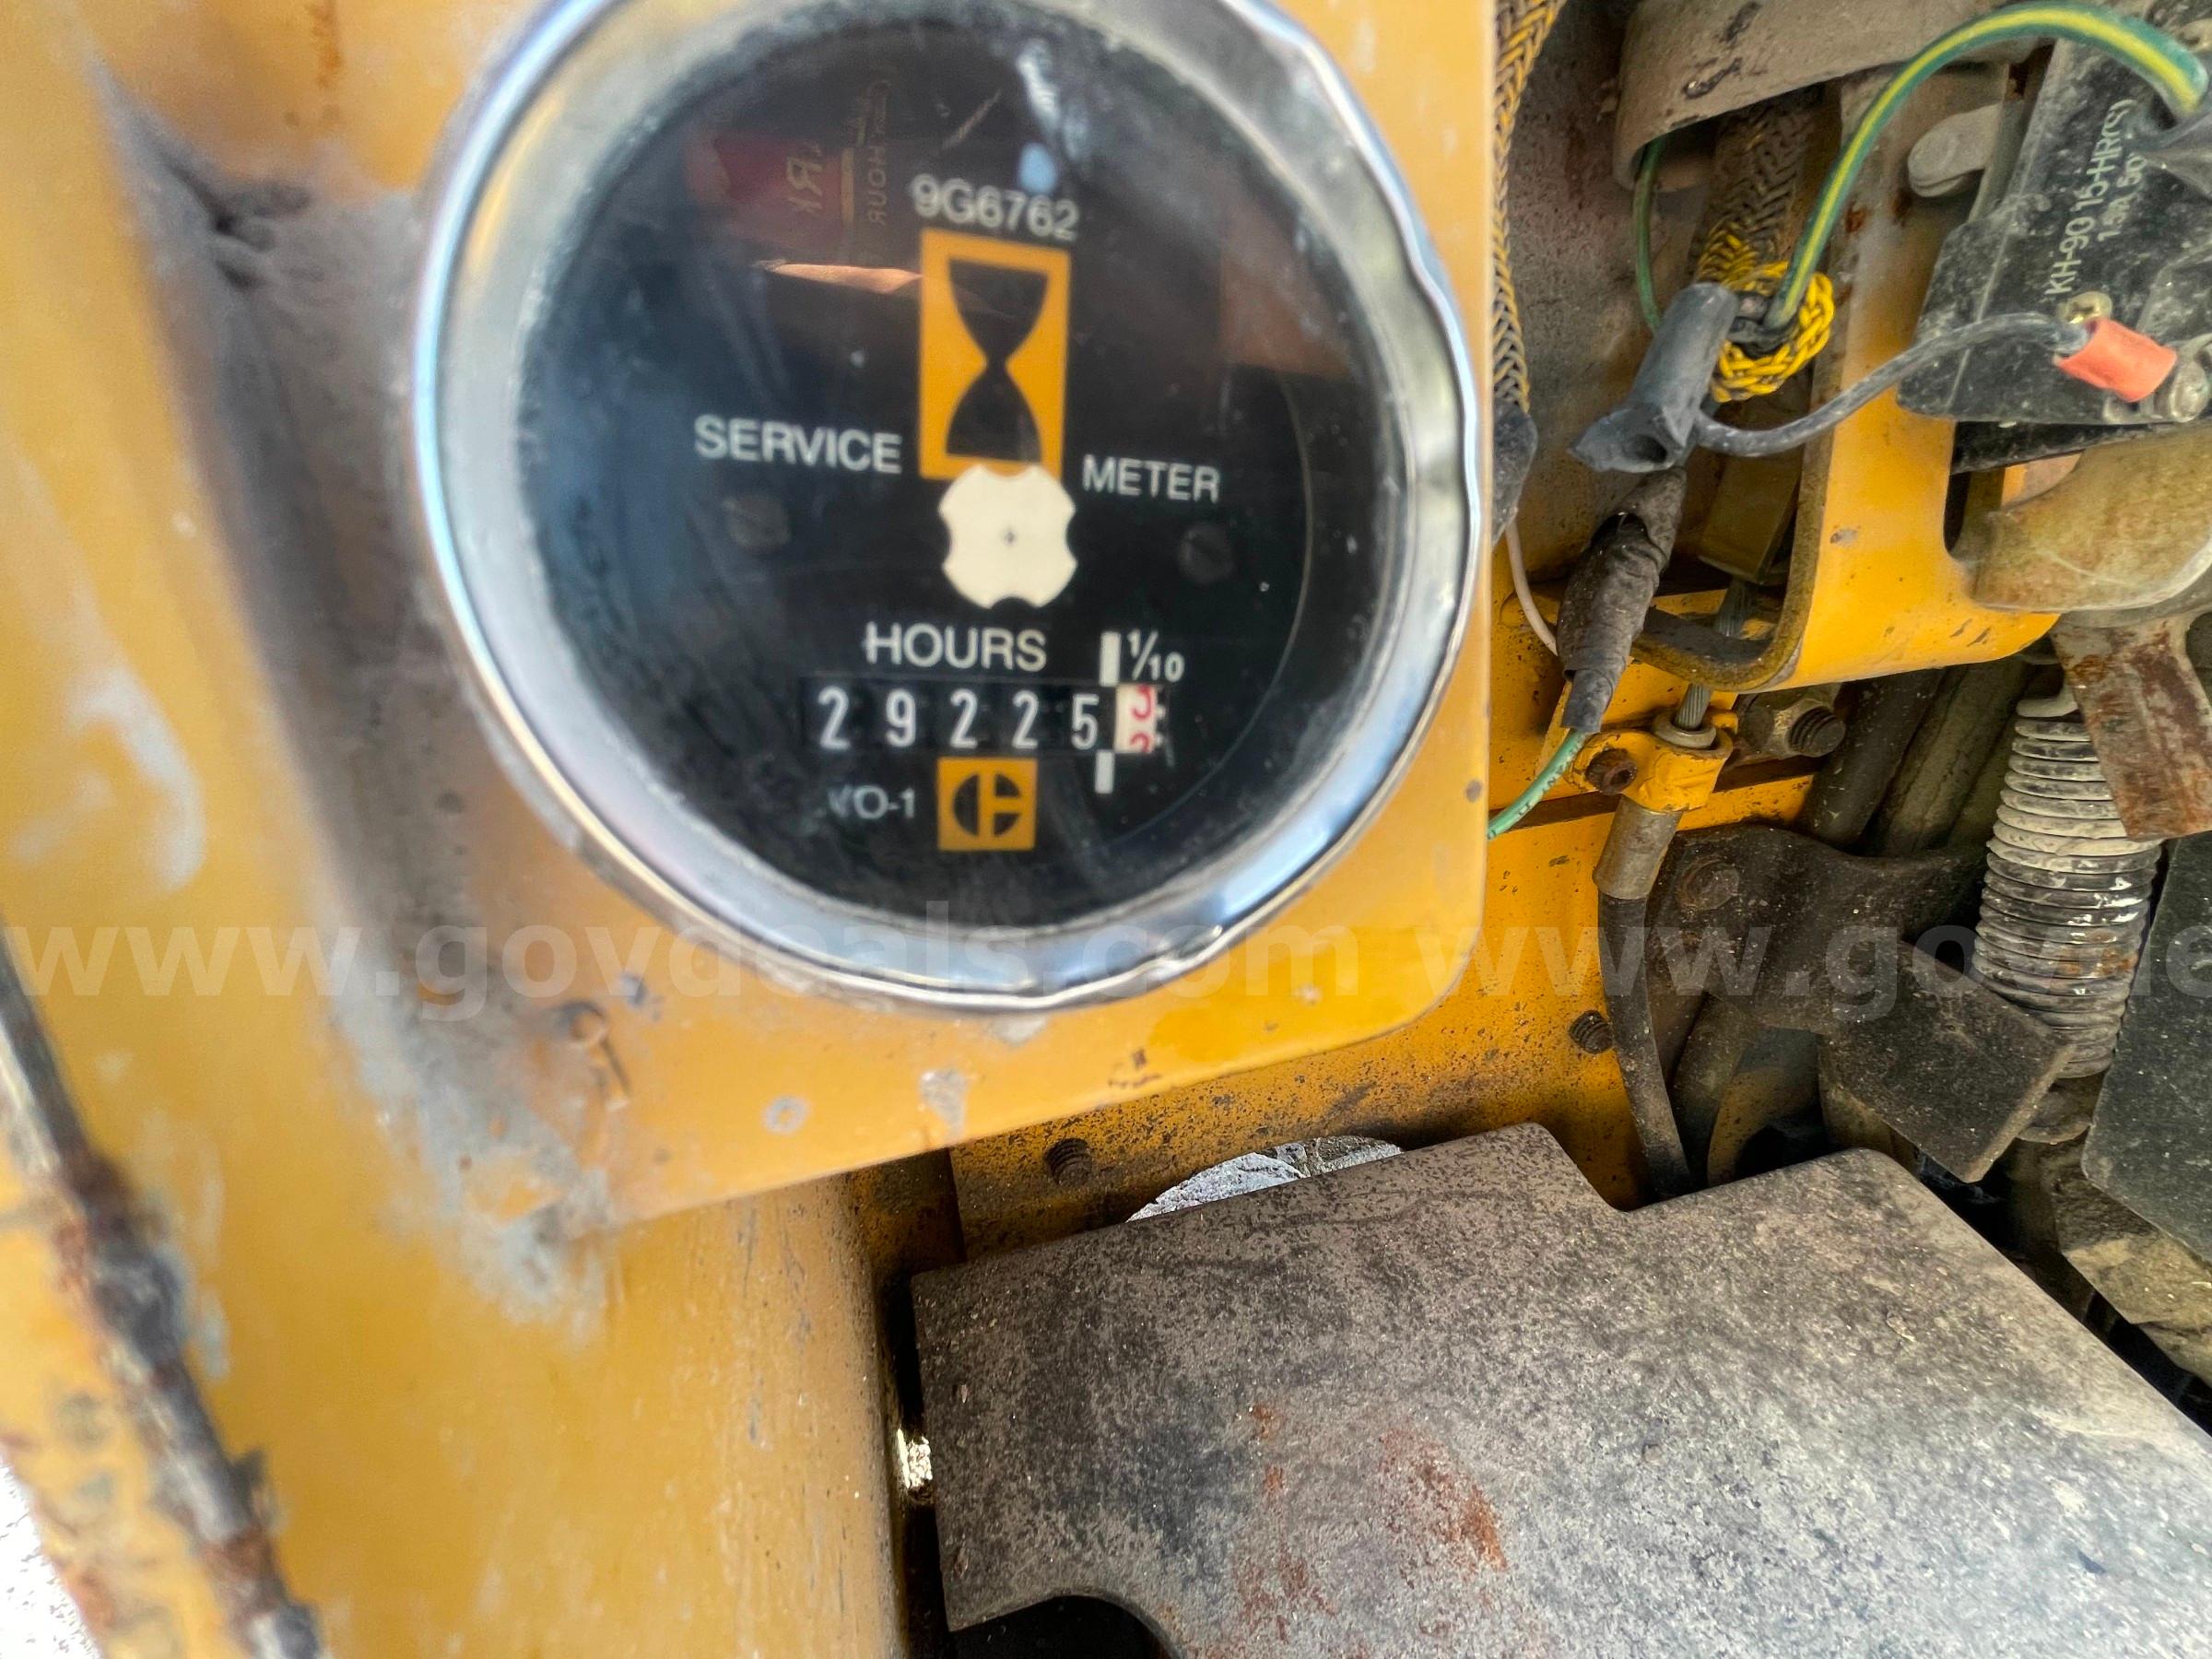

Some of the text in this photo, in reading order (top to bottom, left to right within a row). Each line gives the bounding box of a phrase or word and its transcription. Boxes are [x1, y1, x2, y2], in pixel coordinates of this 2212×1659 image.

[911, 172, 1080, 243] 9G6762
[2044, 217, 2095, 294] KH-90
[693, 414, 1220, 503] SERVICE METER
[864, 621, 1047, 673] HOURS
